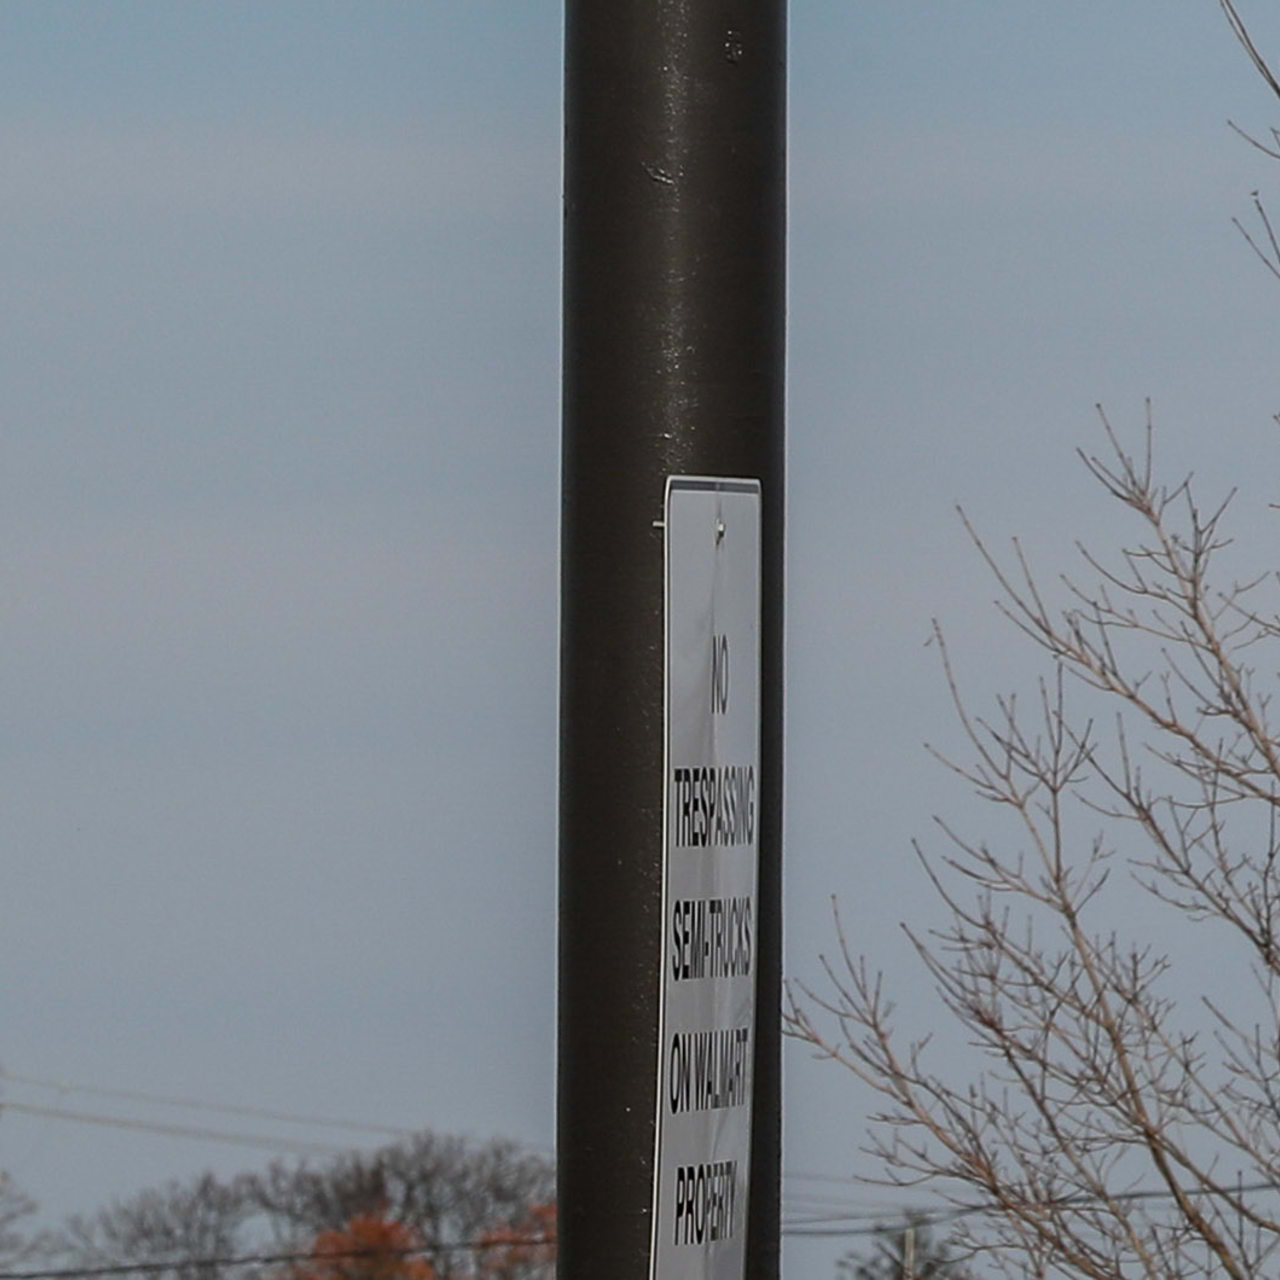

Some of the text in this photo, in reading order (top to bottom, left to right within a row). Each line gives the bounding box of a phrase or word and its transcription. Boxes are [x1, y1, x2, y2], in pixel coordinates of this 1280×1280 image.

[711, 635, 729, 715] NO
[674, 766, 754, 847] TRESPASSING
[672, 897, 752, 981] SEMI-TRUCKS
[670, 1028, 748, 1114] ON WALMART
[675, 1160, 738, 1245] PROPERTY
